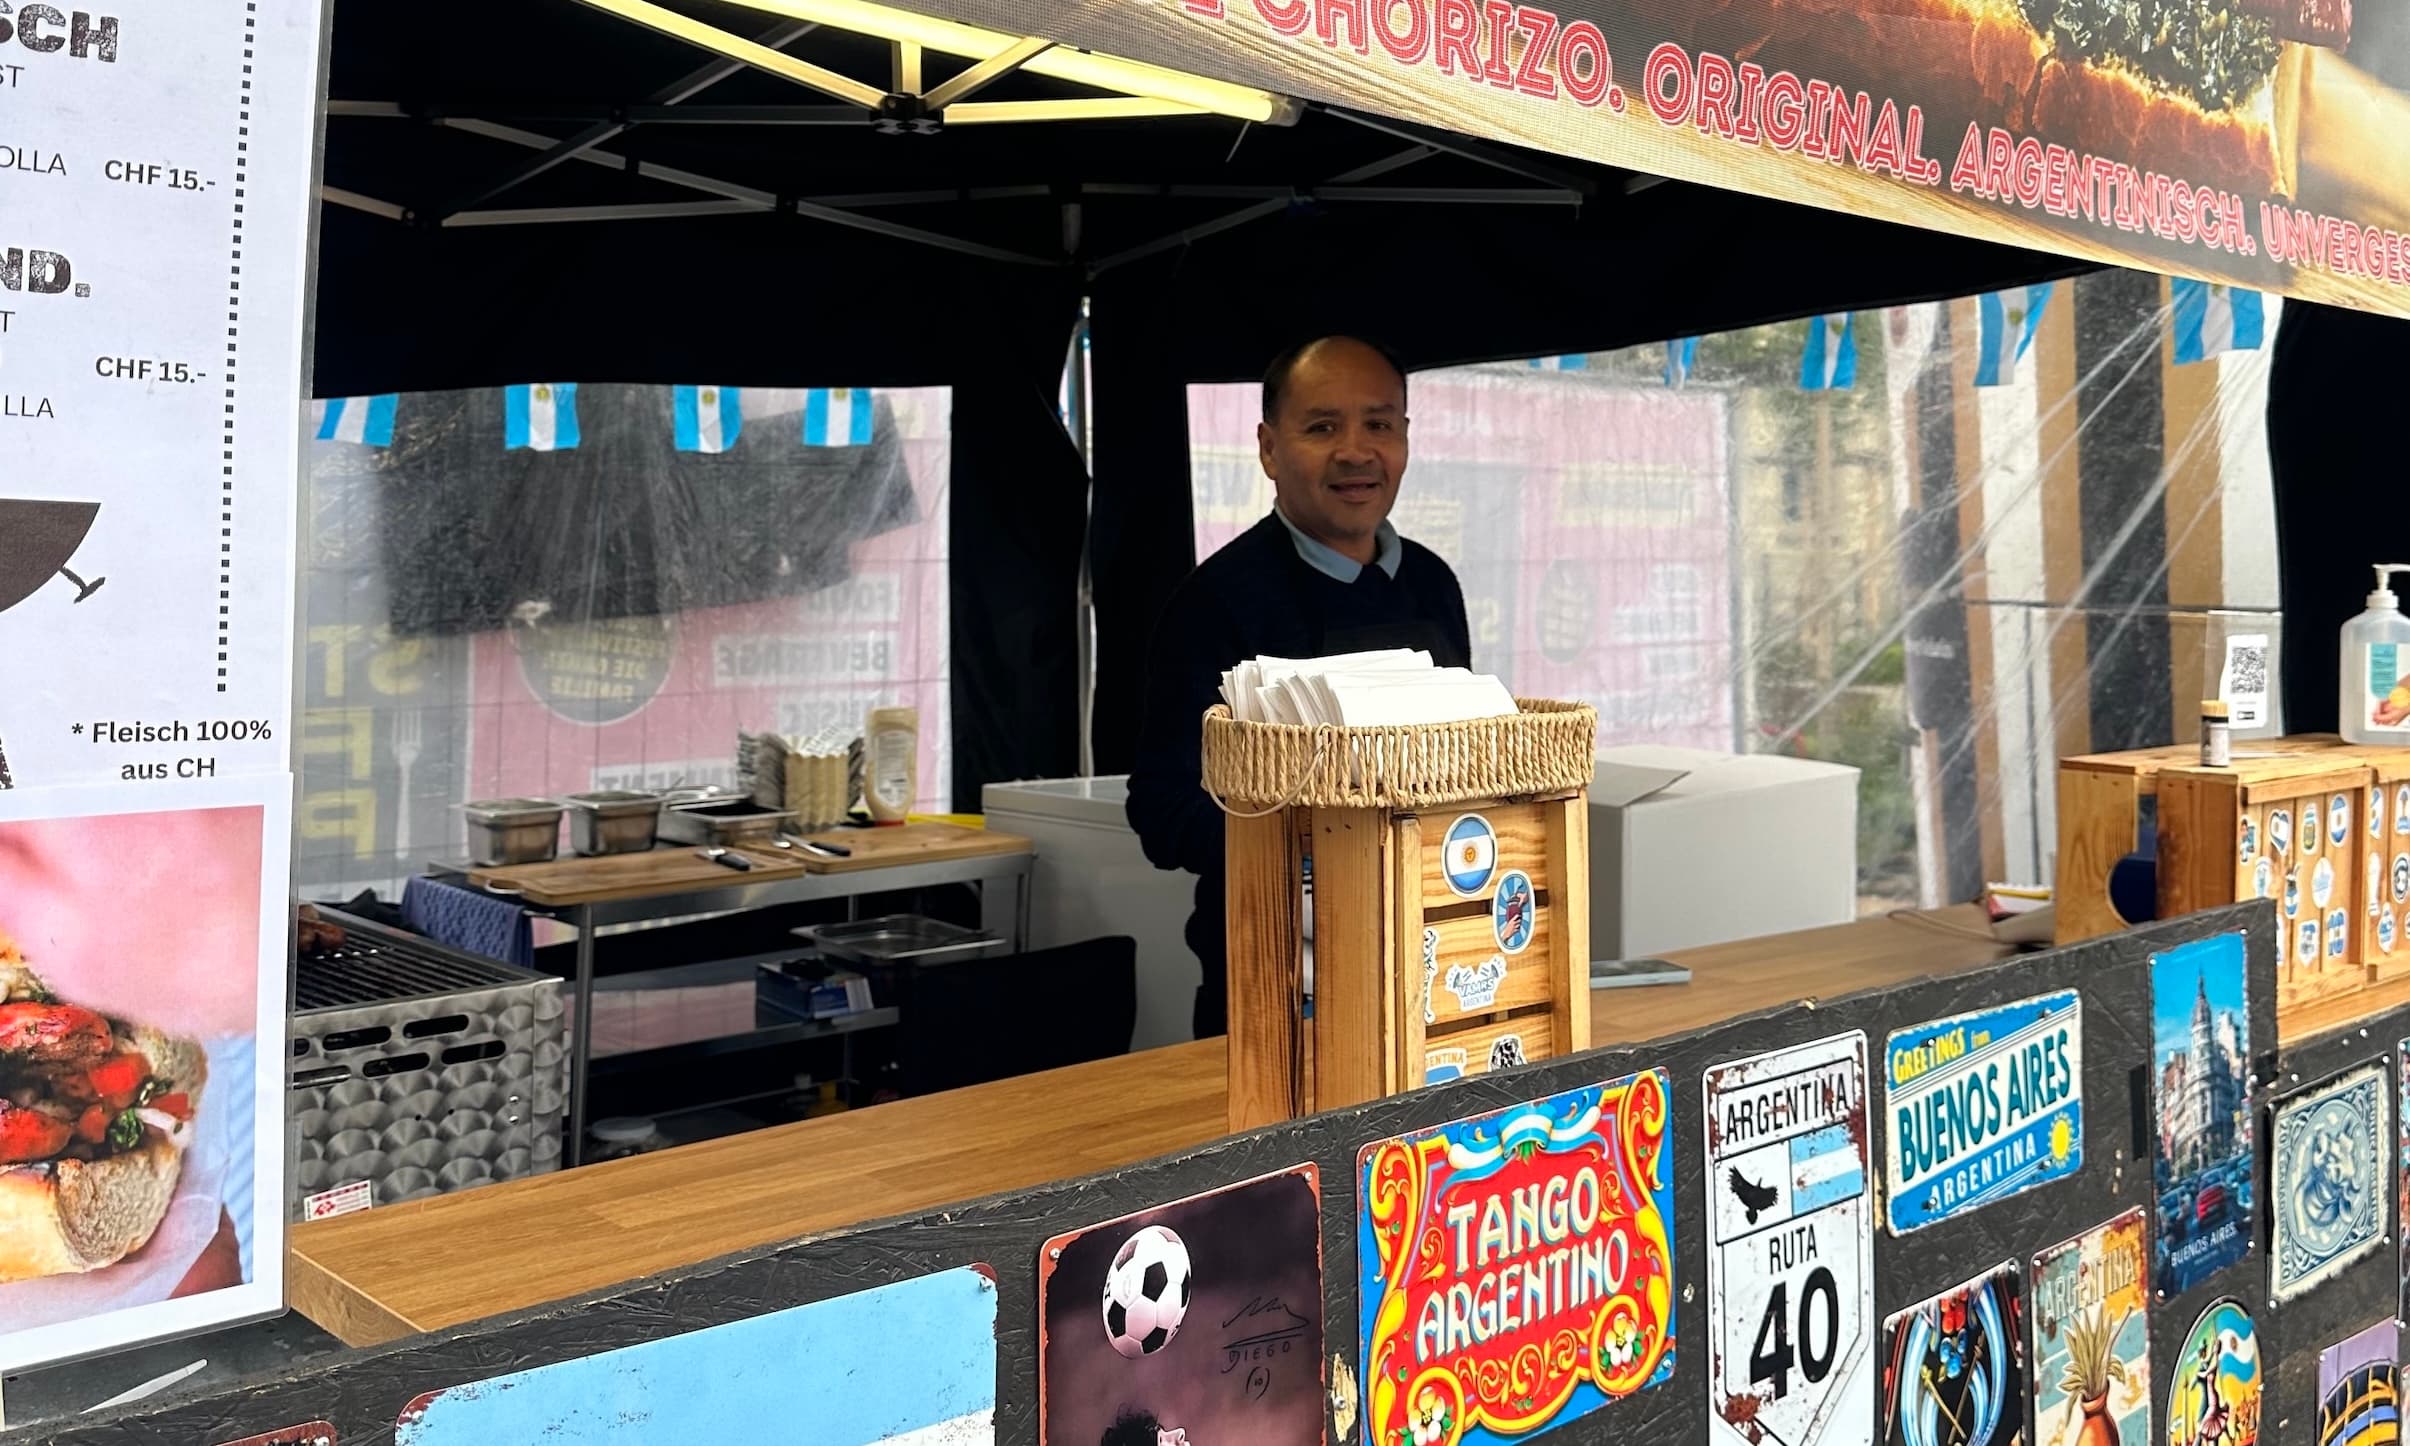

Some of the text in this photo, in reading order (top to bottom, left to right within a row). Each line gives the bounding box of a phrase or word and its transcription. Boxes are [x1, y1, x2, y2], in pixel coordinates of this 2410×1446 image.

[104, 159, 217, 192] CHF 15.-
[1643, 42, 1942, 185] ORIGINAL.
[1951, 120, 2257, 256] ARGENTINISCH.
[95, 356, 207, 384] CHF 15.-
[92, 719, 272, 743] Fleisch 100%
[121, 758, 216, 780] aus CH
[1725, 1071, 1850, 1146] ARGENTINA
[1897, 1028, 2071, 1183] BUENOS AIRES
[1929, 1132, 2037, 1212] ARGENTINA
[1448, 1166, 1601, 1277] TANGO
[1769, 1223, 1818, 1275] RUTA
[2171, 1235, 2209, 1267] BUENOS
[2210, 1221, 2238, 1247] AIRES
[1416, 1228, 1629, 1364] ARGENTINO
[2044, 1245, 2137, 1321] ARGENTINA
[1749, 1266, 1839, 1401] 40
